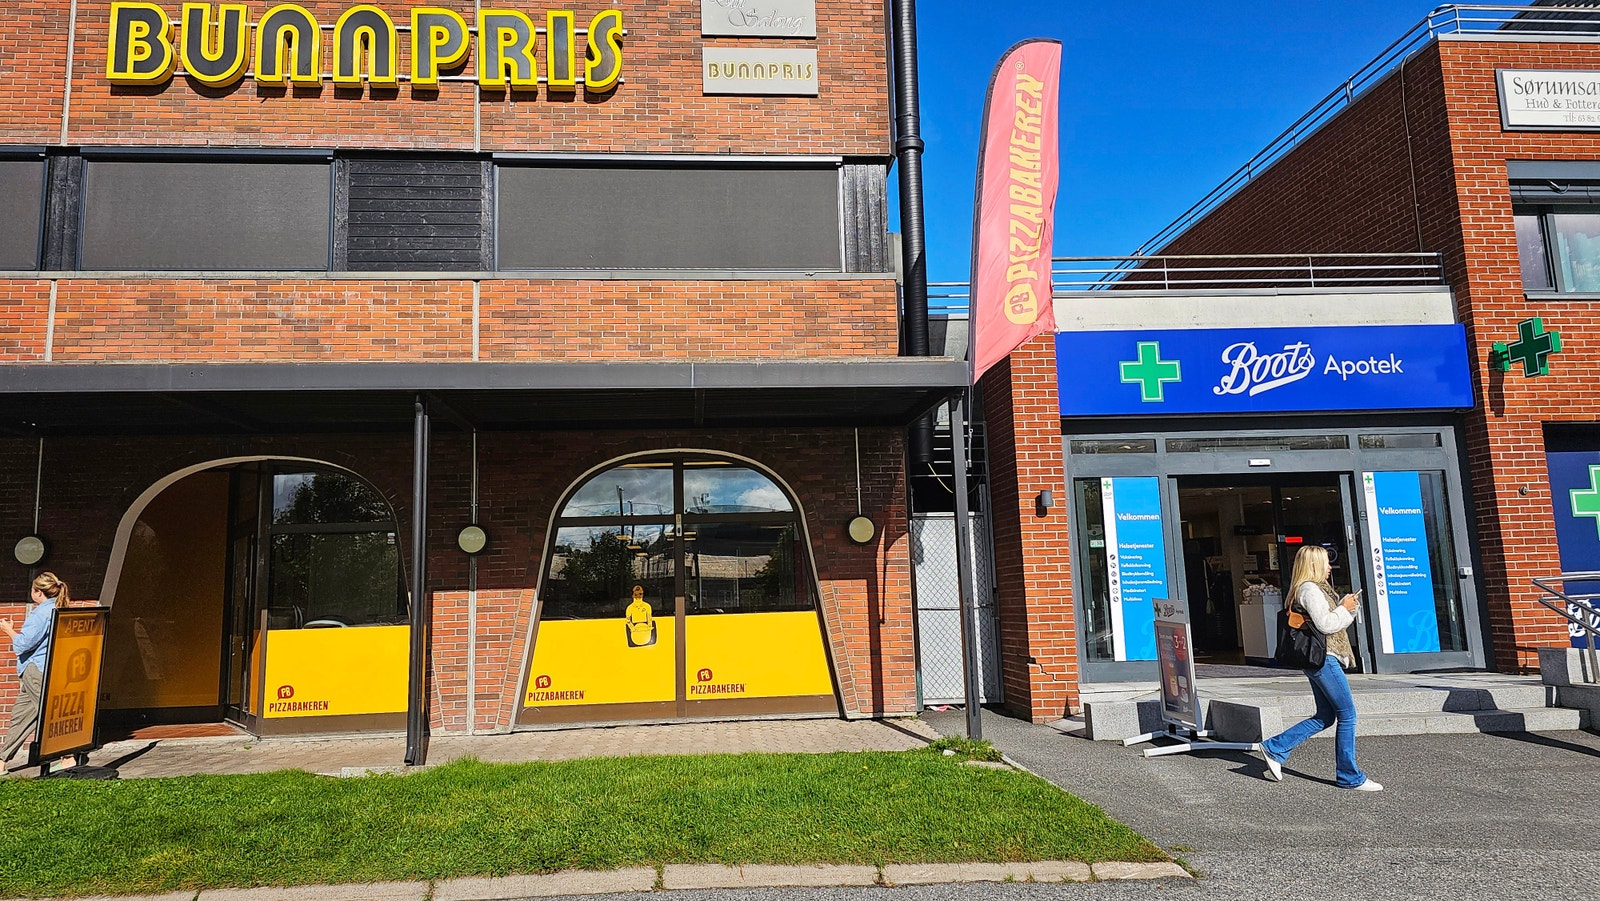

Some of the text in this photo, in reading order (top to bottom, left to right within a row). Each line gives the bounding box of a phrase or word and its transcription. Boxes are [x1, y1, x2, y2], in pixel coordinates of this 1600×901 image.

[106, 2, 624, 92] BUNNPRIS
[707, 61, 813, 80] BUNNPRIS
[1513, 77, 1600, 96] Sørumsa
[1525, 98, 1550, 109] Hud
[1006, 73, 1044, 283] PIZZABAKEREN
[1213, 341, 1315, 396] Boots
[1323, 353, 1404, 381] Apotek
[1379, 507, 1421, 515] Velkommen
[528, 690, 585, 701] PIZZABAKEREN
[690, 683, 745, 695] PIZZABAKEREN
[50, 690, 85, 720] PIZZA
[269, 700, 329, 712] PIZZABAKEREN
[48, 716, 84, 738] BAKEREN
